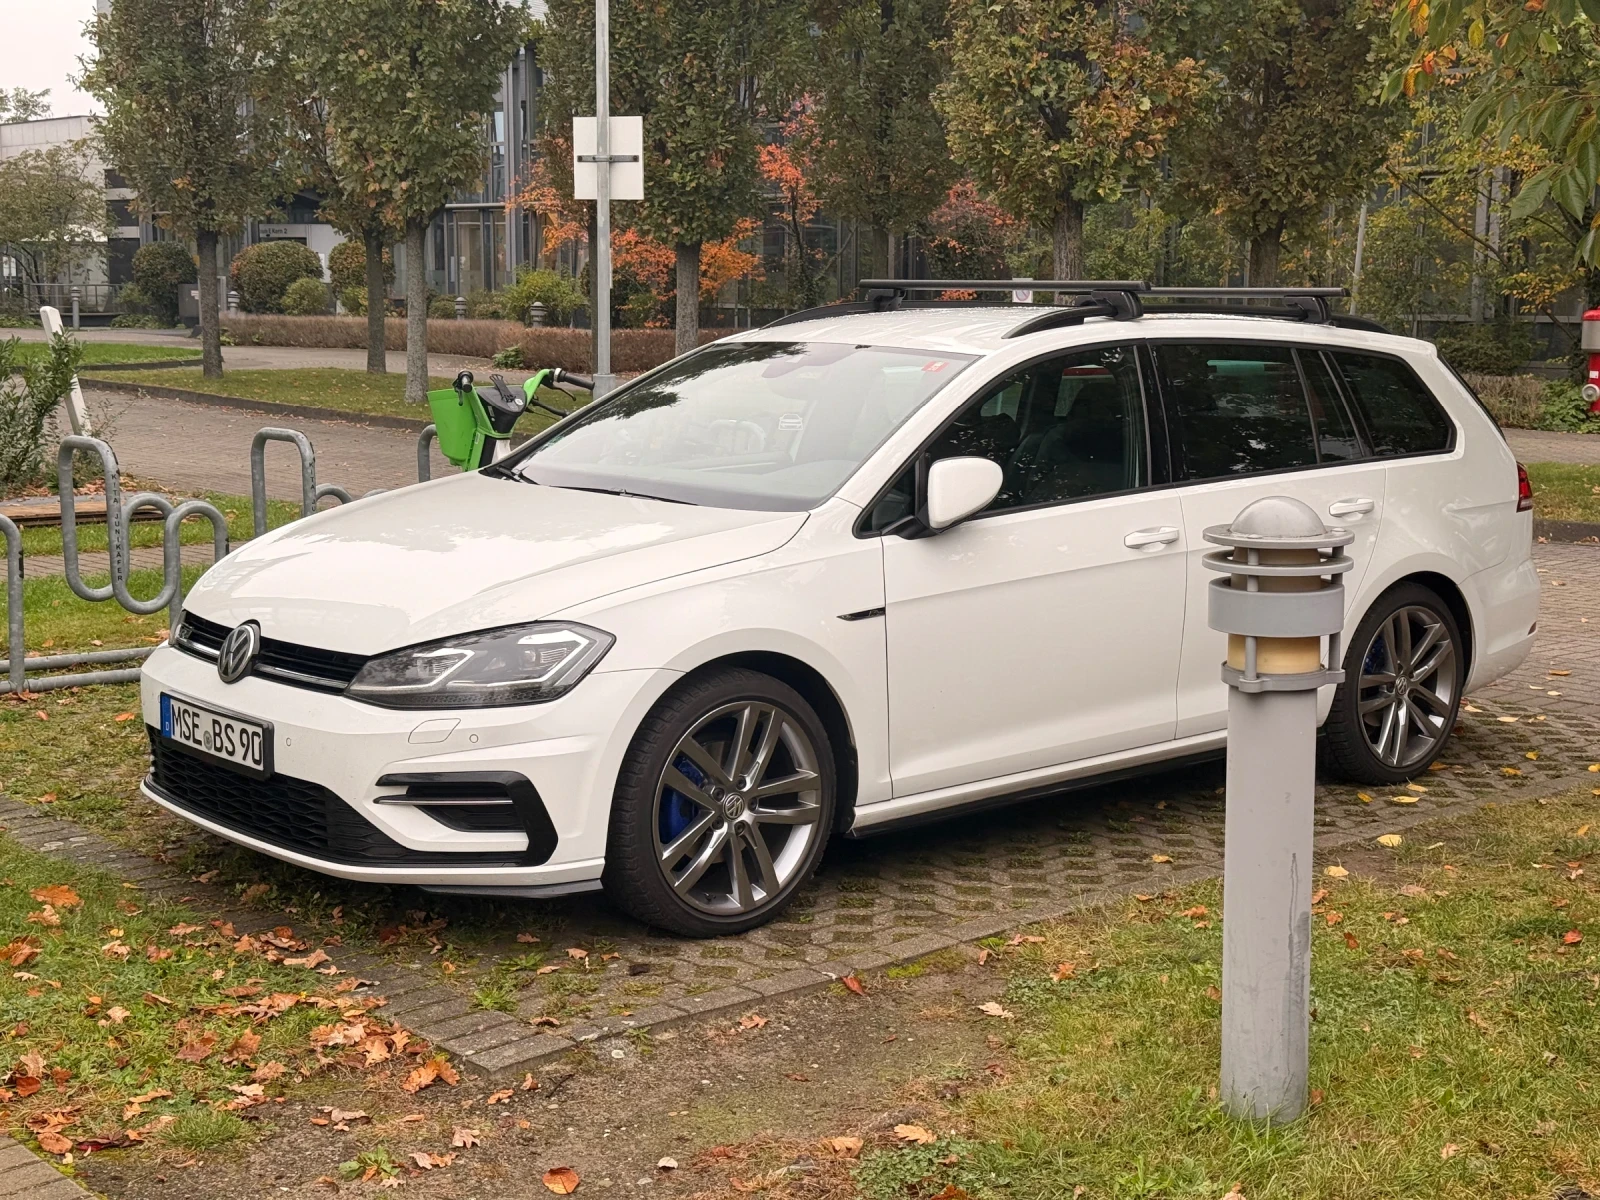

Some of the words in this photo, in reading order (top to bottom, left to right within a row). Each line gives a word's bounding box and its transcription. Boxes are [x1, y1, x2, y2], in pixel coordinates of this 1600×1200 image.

[111, 474, 119, 503] KITA
[165, 722, 169, 731] D
[172, 704, 202, 746] MSE
[212, 719, 235, 757] BS
[239, 728, 262, 766] 90
